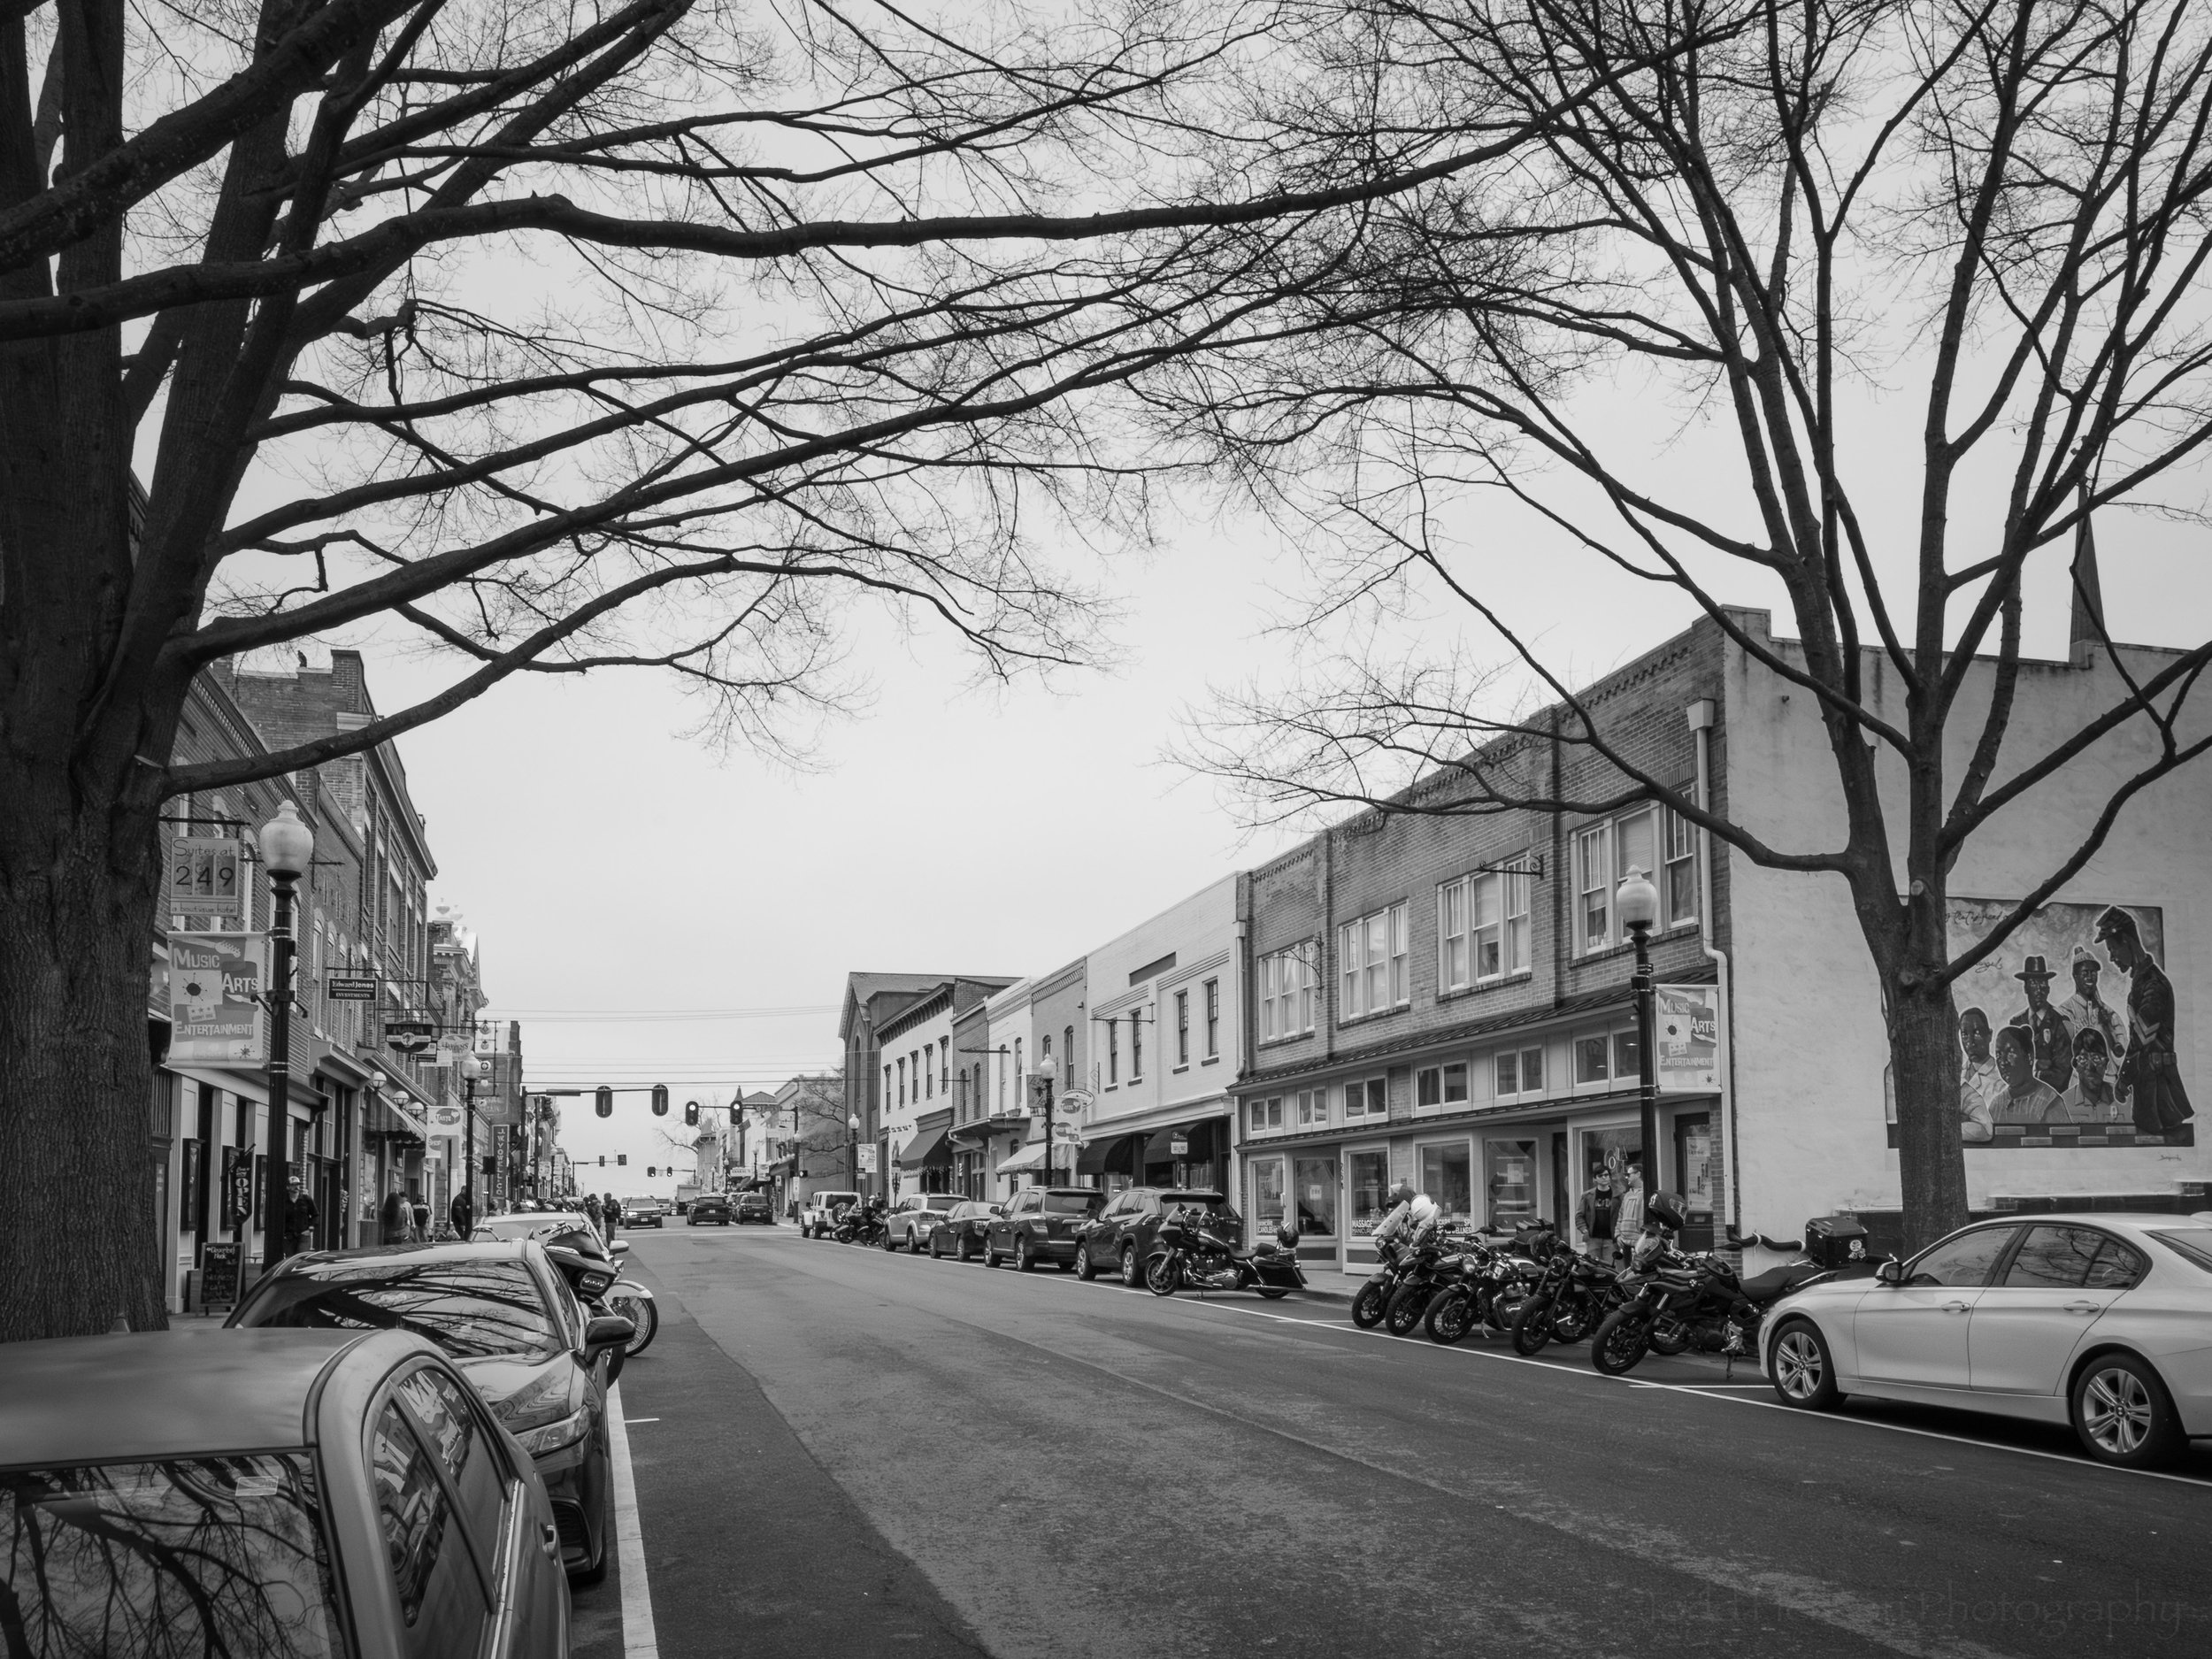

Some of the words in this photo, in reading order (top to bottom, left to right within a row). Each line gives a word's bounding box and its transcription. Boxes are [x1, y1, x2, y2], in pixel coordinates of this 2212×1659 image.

[175, 865, 234, 887] 249
[222, 972, 258, 994] ARTS
[176, 1020, 254, 1036] ENTERTAINMENT
[1691, 1017, 1716, 1033] ARTS
[1660, 1055, 1714, 1068] ENTERTAINMENT
[234, 1177, 250, 1217] OPEN
[1351, 1219, 1373, 1228] MASSAGE
